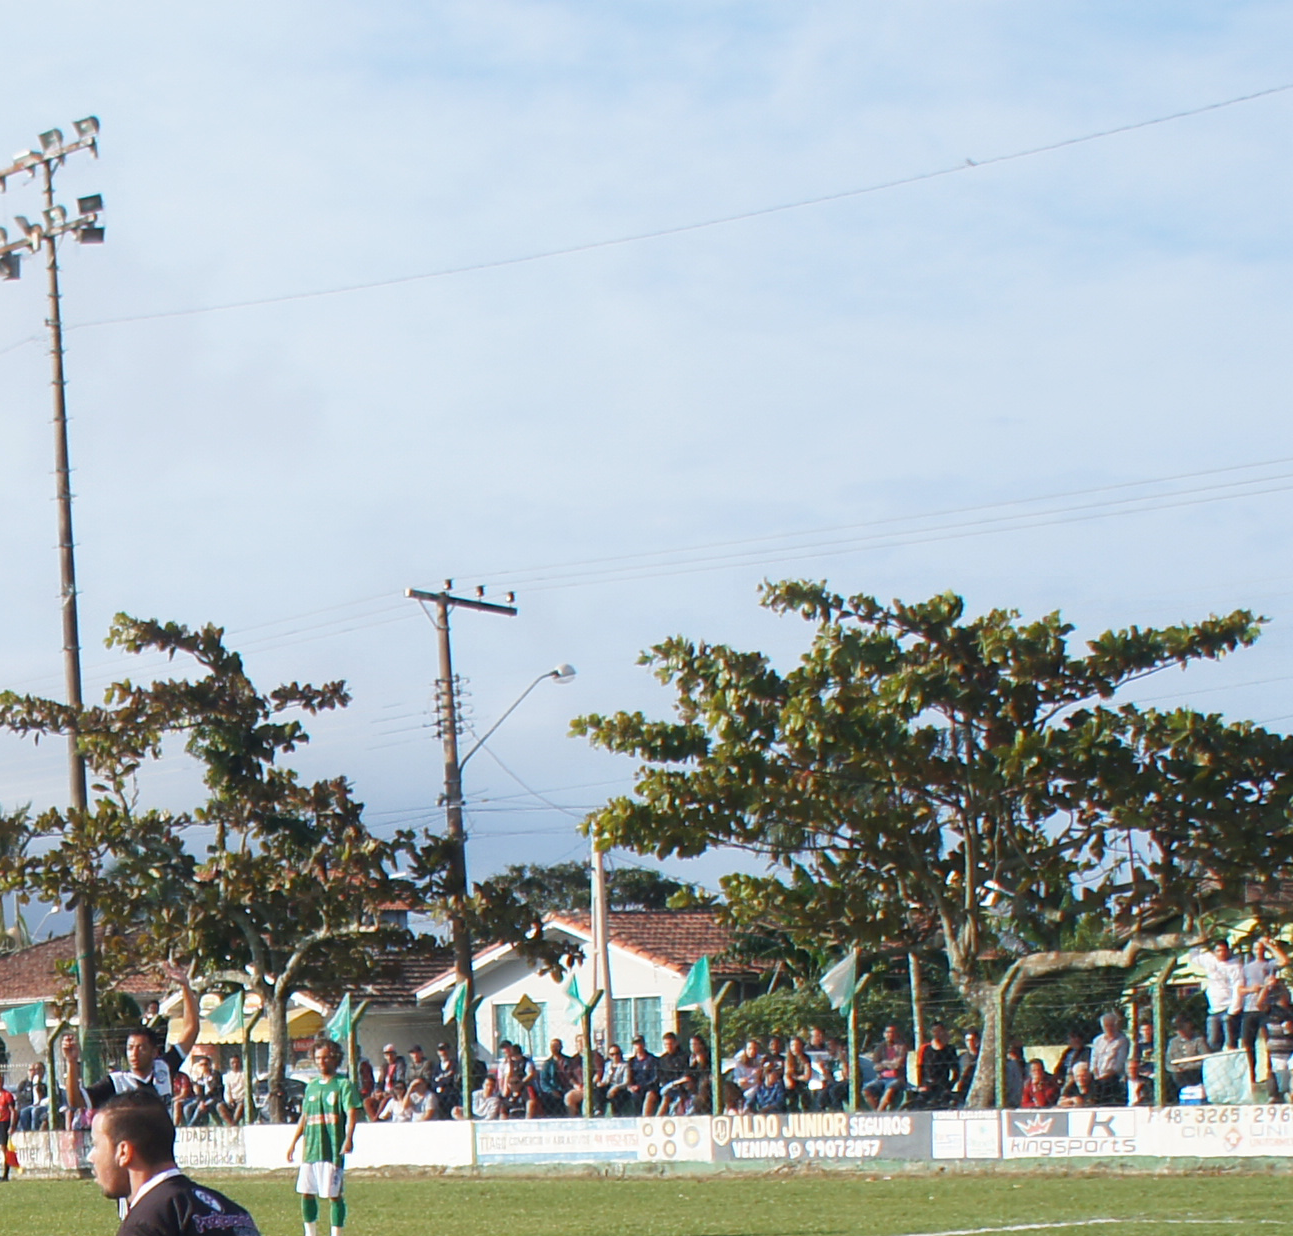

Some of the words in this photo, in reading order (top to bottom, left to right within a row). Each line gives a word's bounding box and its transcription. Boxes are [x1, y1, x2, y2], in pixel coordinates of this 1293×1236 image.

[731, 1116, 778, 1138] ALDO
[782, 1114, 848, 1138] JUNIOR
[849, 1116, 911, 1137] SEGUROS
[732, 1141, 786, 1158] VENDAS
